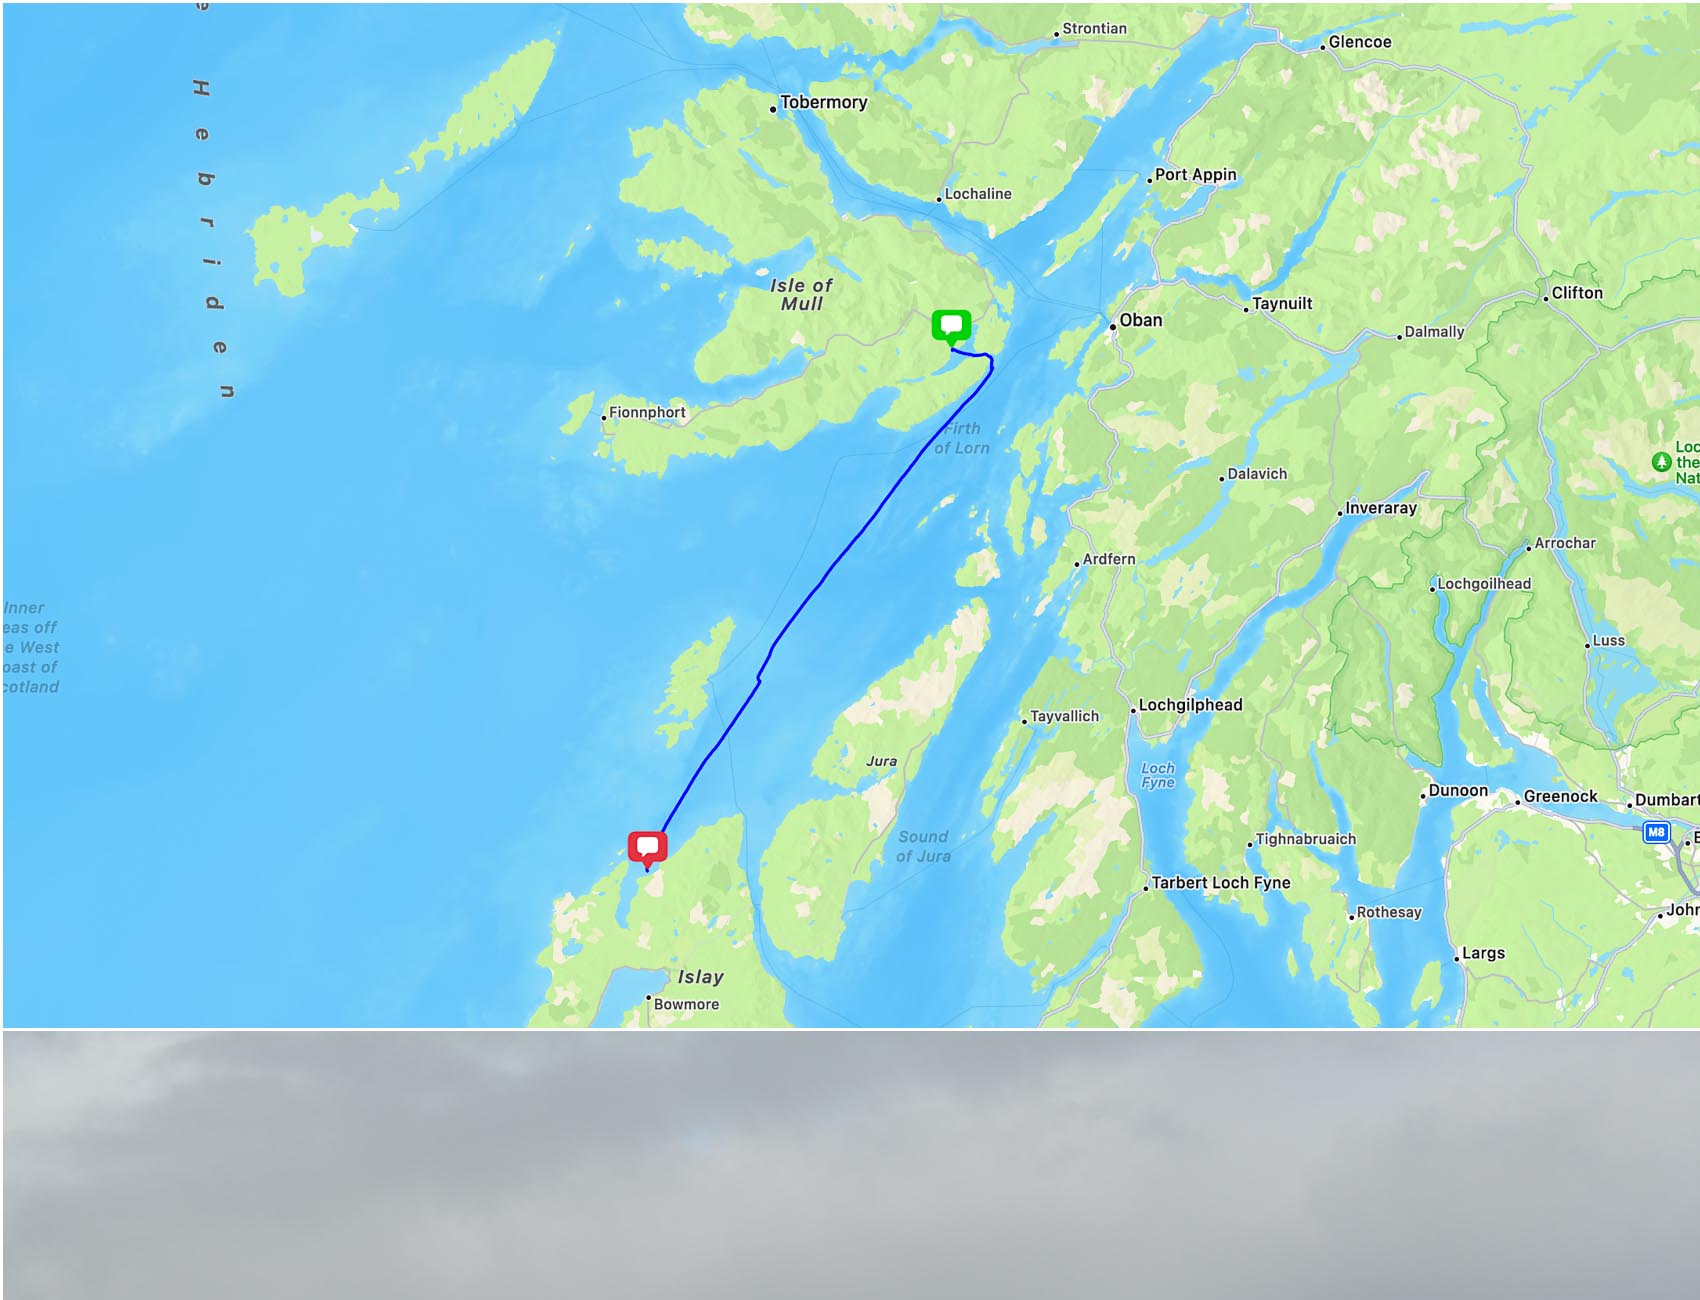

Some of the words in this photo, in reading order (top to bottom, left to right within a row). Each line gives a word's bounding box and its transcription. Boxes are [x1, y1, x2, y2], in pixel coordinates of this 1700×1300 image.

[1063, 22, 1127, 35] Strontian
[1329, 34, 1392, 49] Glencoe
[780, 94, 868, 112] Tobermory
[1155, 167, 1188, 181] Port
[1192, 167, 1237, 184] Appin
[945, 187, 1012, 200] Lochaline
[770, 277, 805, 293] Isle
[812, 277, 834, 293] of
[1552, 285, 1603, 300] Clifton
[781, 295, 824, 311] Mull
[1252, 296, 1313, 313] Taynuilt
[1120, 312, 1163, 327] Oban
[1405, 325, 1465, 340] Dalmally
[609, 405, 686, 421] Fionnphort
[945, 422, 980, 434] Firth
[935, 441, 950, 454] of
[955, 441, 989, 454] Lorn
[1228, 467, 1288, 480] Dalavich
[1346, 501, 1418, 517] Inveraray
[1534, 536, 1597, 549] Arrochar
[1083, 552, 1136, 565] Ardfern
[1437, 577, 1532, 593] Lochgoilhead
[4, 602, 45, 614] Inner
[34, 620, 58, 634] off
[20, 640, 60, 653] West
[1593, 634, 1625, 647] Luss
[41, 660, 59, 673] of
[1139, 697, 1243, 714] Lochgilphead
[1030, 709, 1099, 725] Tayvallich
[866, 755, 898, 767] Jura
[1142, 762, 1175, 774] Loch
[1142, 777, 1175, 789] Fyne
[1429, 783, 1488, 797] Dunoon
[1524, 789, 1598, 803] Greenock
[899, 830, 949, 843] Sound
[1649, 827, 1665, 837] M8
[1255, 832, 1357, 848] Tighnabruaich
[897, 850, 912, 862] of
[917, 850, 951, 862] Jura
[1151, 875, 1208, 889] Tarbert
[1212, 875, 1249, 889] Loch
[1254, 875, 1291, 892] Fyne
[1357, 905, 1422, 921] Rothesay
[1463, 946, 1506, 962] Largs
[678, 969, 725, 988] Islay
[654, 998, 720, 1010] Bowmore
